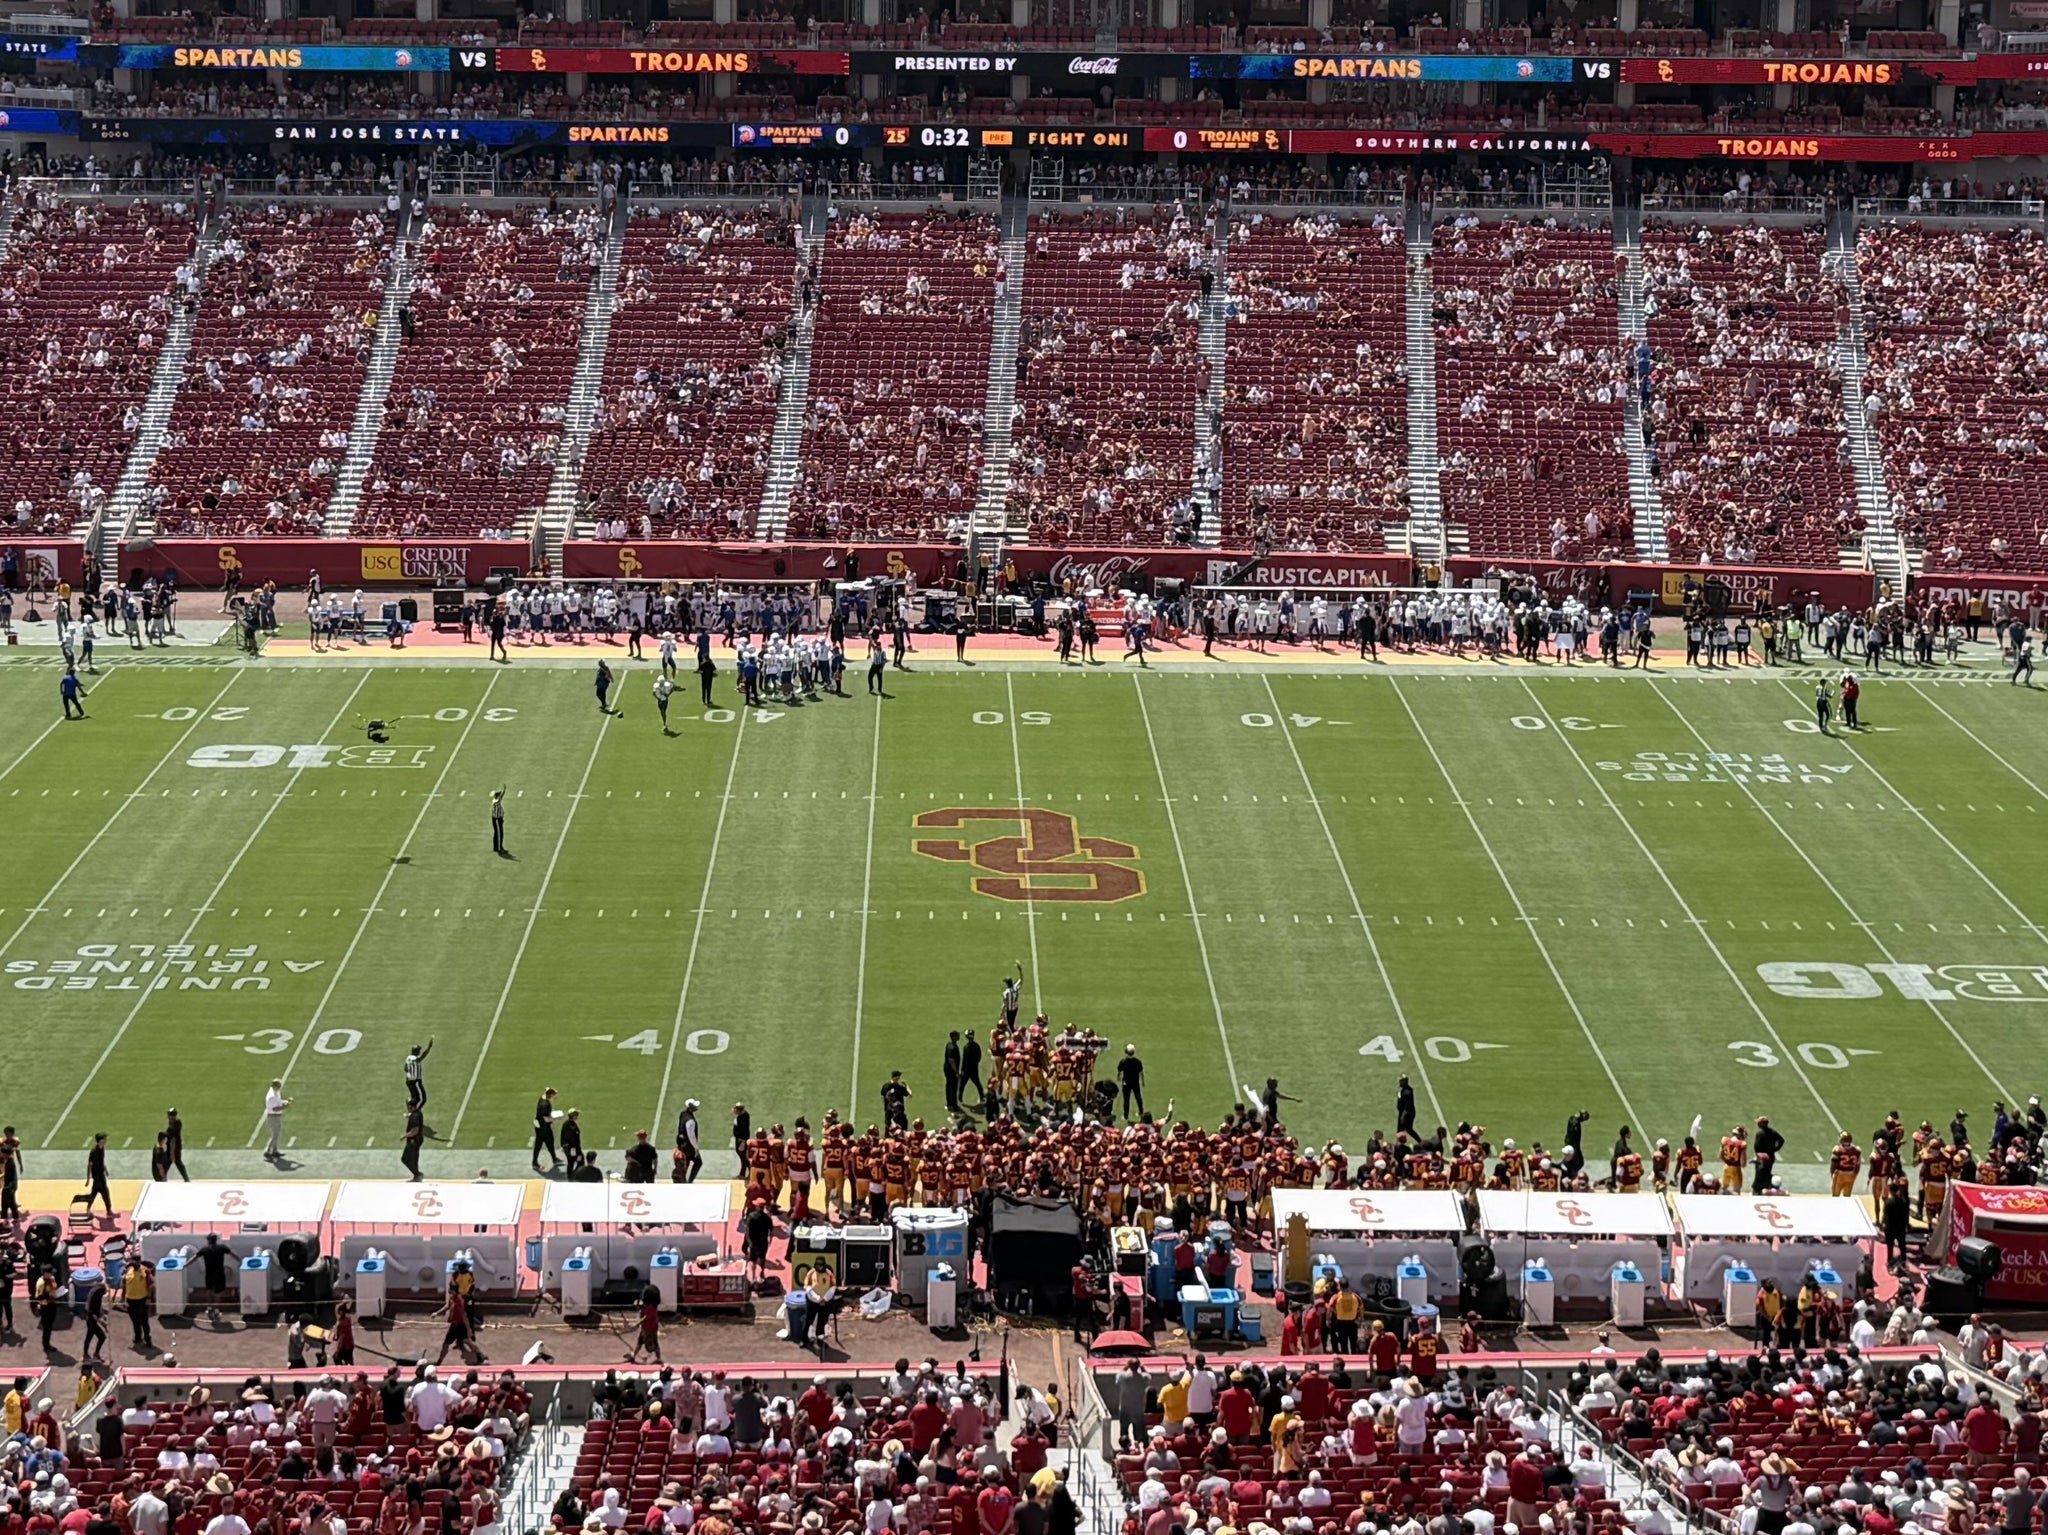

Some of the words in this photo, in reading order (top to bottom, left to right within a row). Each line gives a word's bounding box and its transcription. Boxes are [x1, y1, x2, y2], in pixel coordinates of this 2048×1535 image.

[5, 42, 47, 53] STATE
[174, 48, 302, 67] SPARTANS
[460, 51, 487, 68] VS
[630, 52, 748, 72] TROJANS
[895, 57, 990, 71] PRESENTED
[994, 57, 1017, 72] BY
[1294, 59, 1422, 79] SPARTANS
[1583, 63, 1610, 79] VS
[1764, 62, 1890, 84] TROJANS
[275, 127, 316, 140] SAN
[330, 125, 381, 140] JOSÉ
[394, 128, 460, 140] STATE
[568, 127, 669, 143] SPARTANS
[760, 127, 822, 137] SPARTANS
[835, 127, 849, 145] 0
[886, 130, 906, 144] 25
[921, 128, 970, 146] 0:32
[1028, 131, 1086, 146] FIGHT
[1173, 131, 1187, 149] 0
[1198, 130, 1259, 142] TROJANS
[1355, 137, 1457, 149] SOUTHERN
[1469, 138, 1591, 151] CALIFORNIA
[1718, 139, 1819, 157] TROJANS
[364, 556, 399, 570] USC
[402, 548, 471, 562] CREDIT
[1635, 752, 1785, 763] FIELD
[1596, 761, 1853, 774] AIRLINES
[1622, 772, 1833, 784] UNITED
[77, 944, 259, 957] FIELD
[4, 960, 325, 974] AIRLINES
[14, 976, 271, 990] UNITED
[242, 1029, 363, 1055] 30
[616, 1029, 730, 1056] 40
[1358, 1035, 1473, 1063] 40
[1727, 1041, 1849, 1069] 30
[1008, 1060, 1025, 1075] 24
[1056, 1062, 1073, 1077] 97
[750, 1147, 768, 1162] 75
[826, 1148, 842, 1162] 29
[1839, 1154, 1858, 1168] 23
[887, 1163, 902, 1179] 52
[1303, 1168, 1313, 1183] 8
[217, 1190, 249, 1216] SC
[412, 1190, 443, 1217] SC
[620, 1190, 651, 1216] SC
[1349, 1198, 1384, 1223] SC
[1987, 1201, 2003, 1209] of
[2006, 1198, 2047, 1209] USC
[1555, 1199, 1593, 1226] SC
[1754, 1203, 1794, 1229] SC
[1418, 1341, 1437, 1357] 55
[33, 1421, 49, 1440] 10
